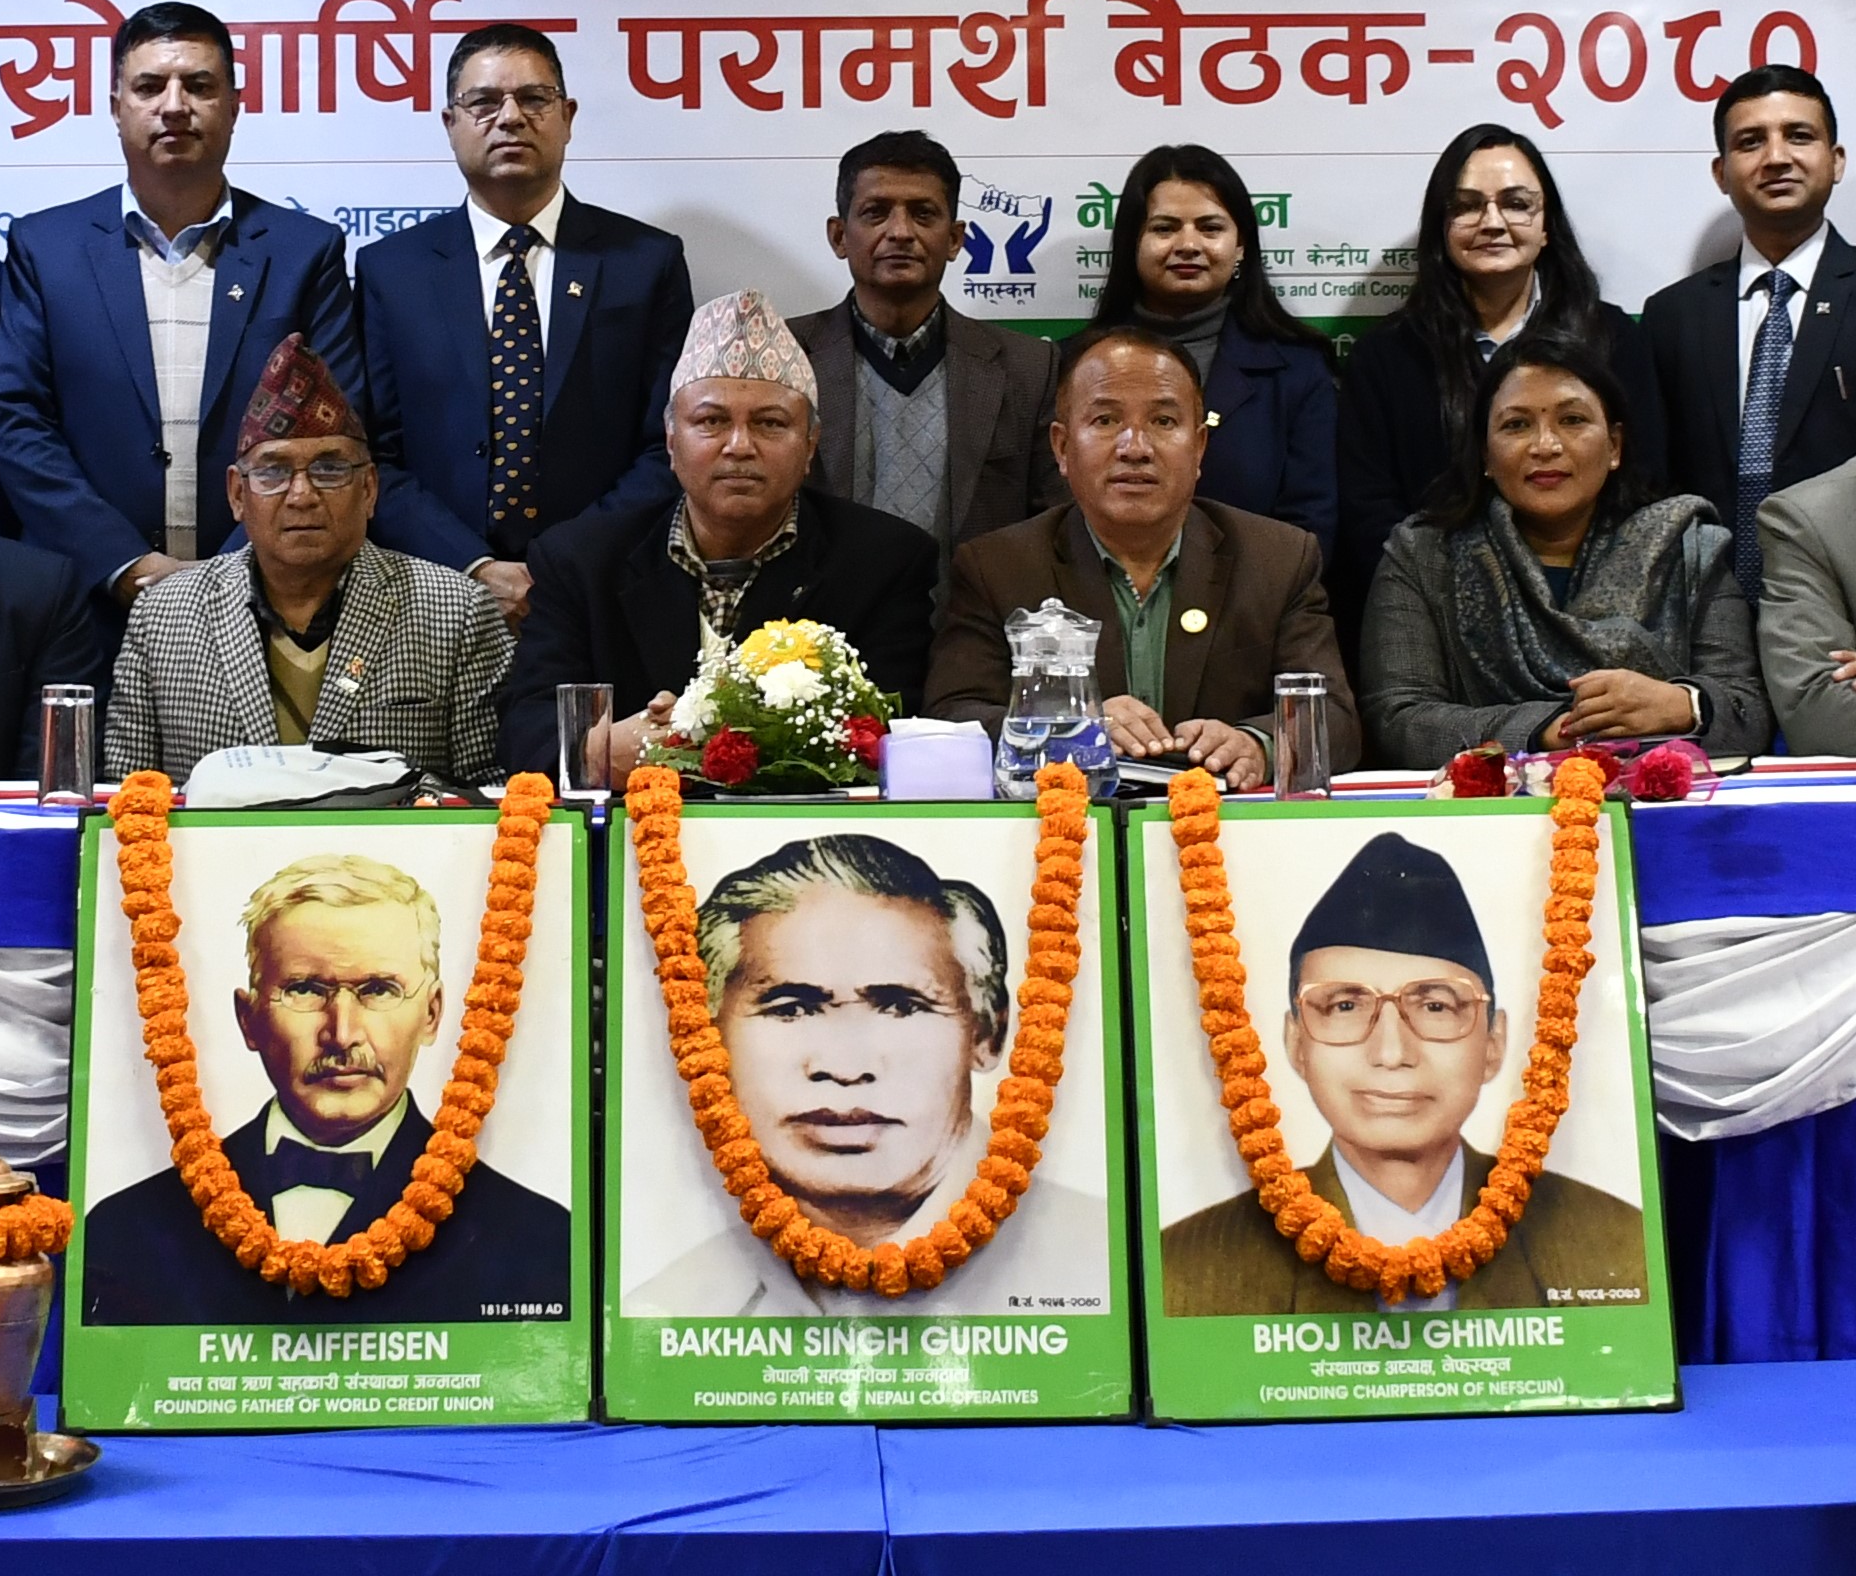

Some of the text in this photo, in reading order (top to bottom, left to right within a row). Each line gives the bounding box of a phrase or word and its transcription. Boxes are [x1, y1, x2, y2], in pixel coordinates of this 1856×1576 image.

[1306, 242, 1369, 267] केन्द्रीय
[1290, 283, 1317, 296] and
[1322, 282, 1365, 296] Credit
[545, 1303, 563, 1315] AD
[660, 1324, 1069, 1357] BAKHAN SINGH GURUNG
[1253, 1316, 1565, 1354] BHOJ RAJ GHIMIRE
[199, 1331, 449, 1363] F.W. RAIFFEISEN
[167, 1376, 203, 1392] बचत
[207, 1376, 237, 1391] तथा
[242, 1376, 273, 1391] ऋण
[278, 1371, 339, 1394] सहकारी
[762, 1364, 809, 1384] नेपाली
[694, 1391, 777, 1406] FOUNDING
[781, 1391, 834, 1406] FATHER
[839, 1390, 861, 1406] OF
[865, 1390, 915, 1405] NEPALI
[1259, 1377, 1564, 1403] (FOUNDING CHAIRPERSON OF NEFSCUN)
[154, 1396, 494, 1414] FOUNDING FATHER OF WORLD CREDIT UNION
